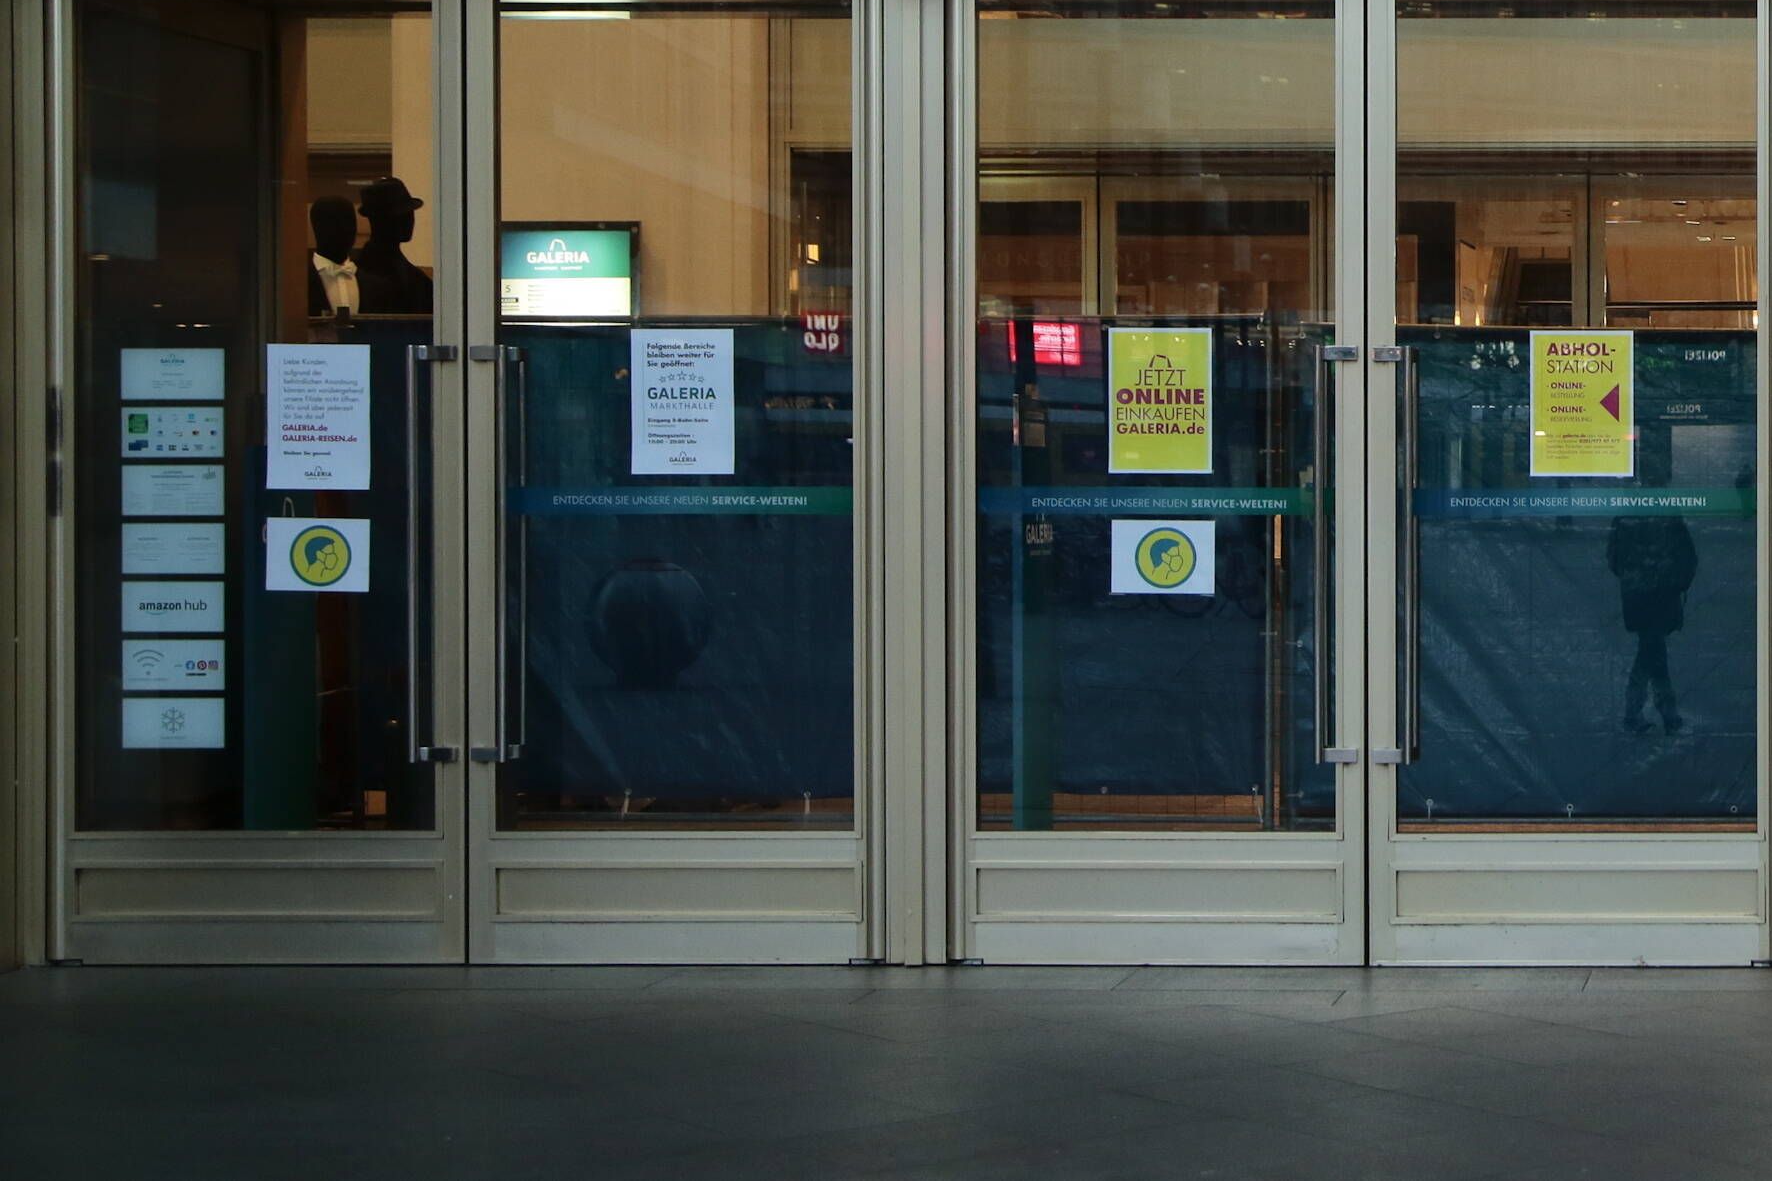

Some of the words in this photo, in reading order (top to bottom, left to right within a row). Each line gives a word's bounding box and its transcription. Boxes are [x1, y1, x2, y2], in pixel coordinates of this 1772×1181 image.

[527, 251, 590, 264] GALERIA
[647, 343, 682, 351] Folgende
[684, 343, 716, 351] Bereiche
[1546, 343, 1616, 356] ABHOL-
[647, 351, 675, 359] bleiben
[678, 351, 701, 359] weiter
[703, 351, 715, 359] für
[647, 360, 658, 368] Sie
[1546, 360, 1614, 374] STATION
[1135, 369, 1186, 387] JETZT
[648, 387, 716, 400] GALERIA
[1116, 389, 1206, 405] ONLINE
[650, 402, 715, 411] MARKTHALLE
[1116, 407, 1206, 421] EINKAUFEN
[282, 423, 328, 432] GALERIA.de
[1116, 421, 1206, 435] GALERIA.de
[282, 435, 358, 443] GALERIA-REISEN.de
[552, 495, 613, 507] ENTDECKEN
[615, 495, 629, 507] SIE
[632, 495, 671, 507] UNSERE
[673, 495, 709, 507] NEUEN
[712, 495, 808, 507] SERVICE-WELTEN!
[1031, 497, 1091, 509] ENTDECKEN
[1094, 497, 1108, 509] SIE
[1111, 497, 1150, 509] UNSERE
[1152, 497, 1188, 509] NEUEN
[1191, 497, 1287, 509] SERVICE-WELTEN!
[1450, 497, 1510, 508] ENTDECKEN
[1512, 497, 1527, 508] SIE
[1530, 497, 1569, 508] UNSERE
[1572, 497, 1608, 508] NEUEN
[1610, 497, 1707, 508] SERVICE-WELTEN!
[139, 602, 182, 611] amazon
[184, 599, 207, 611] hub
